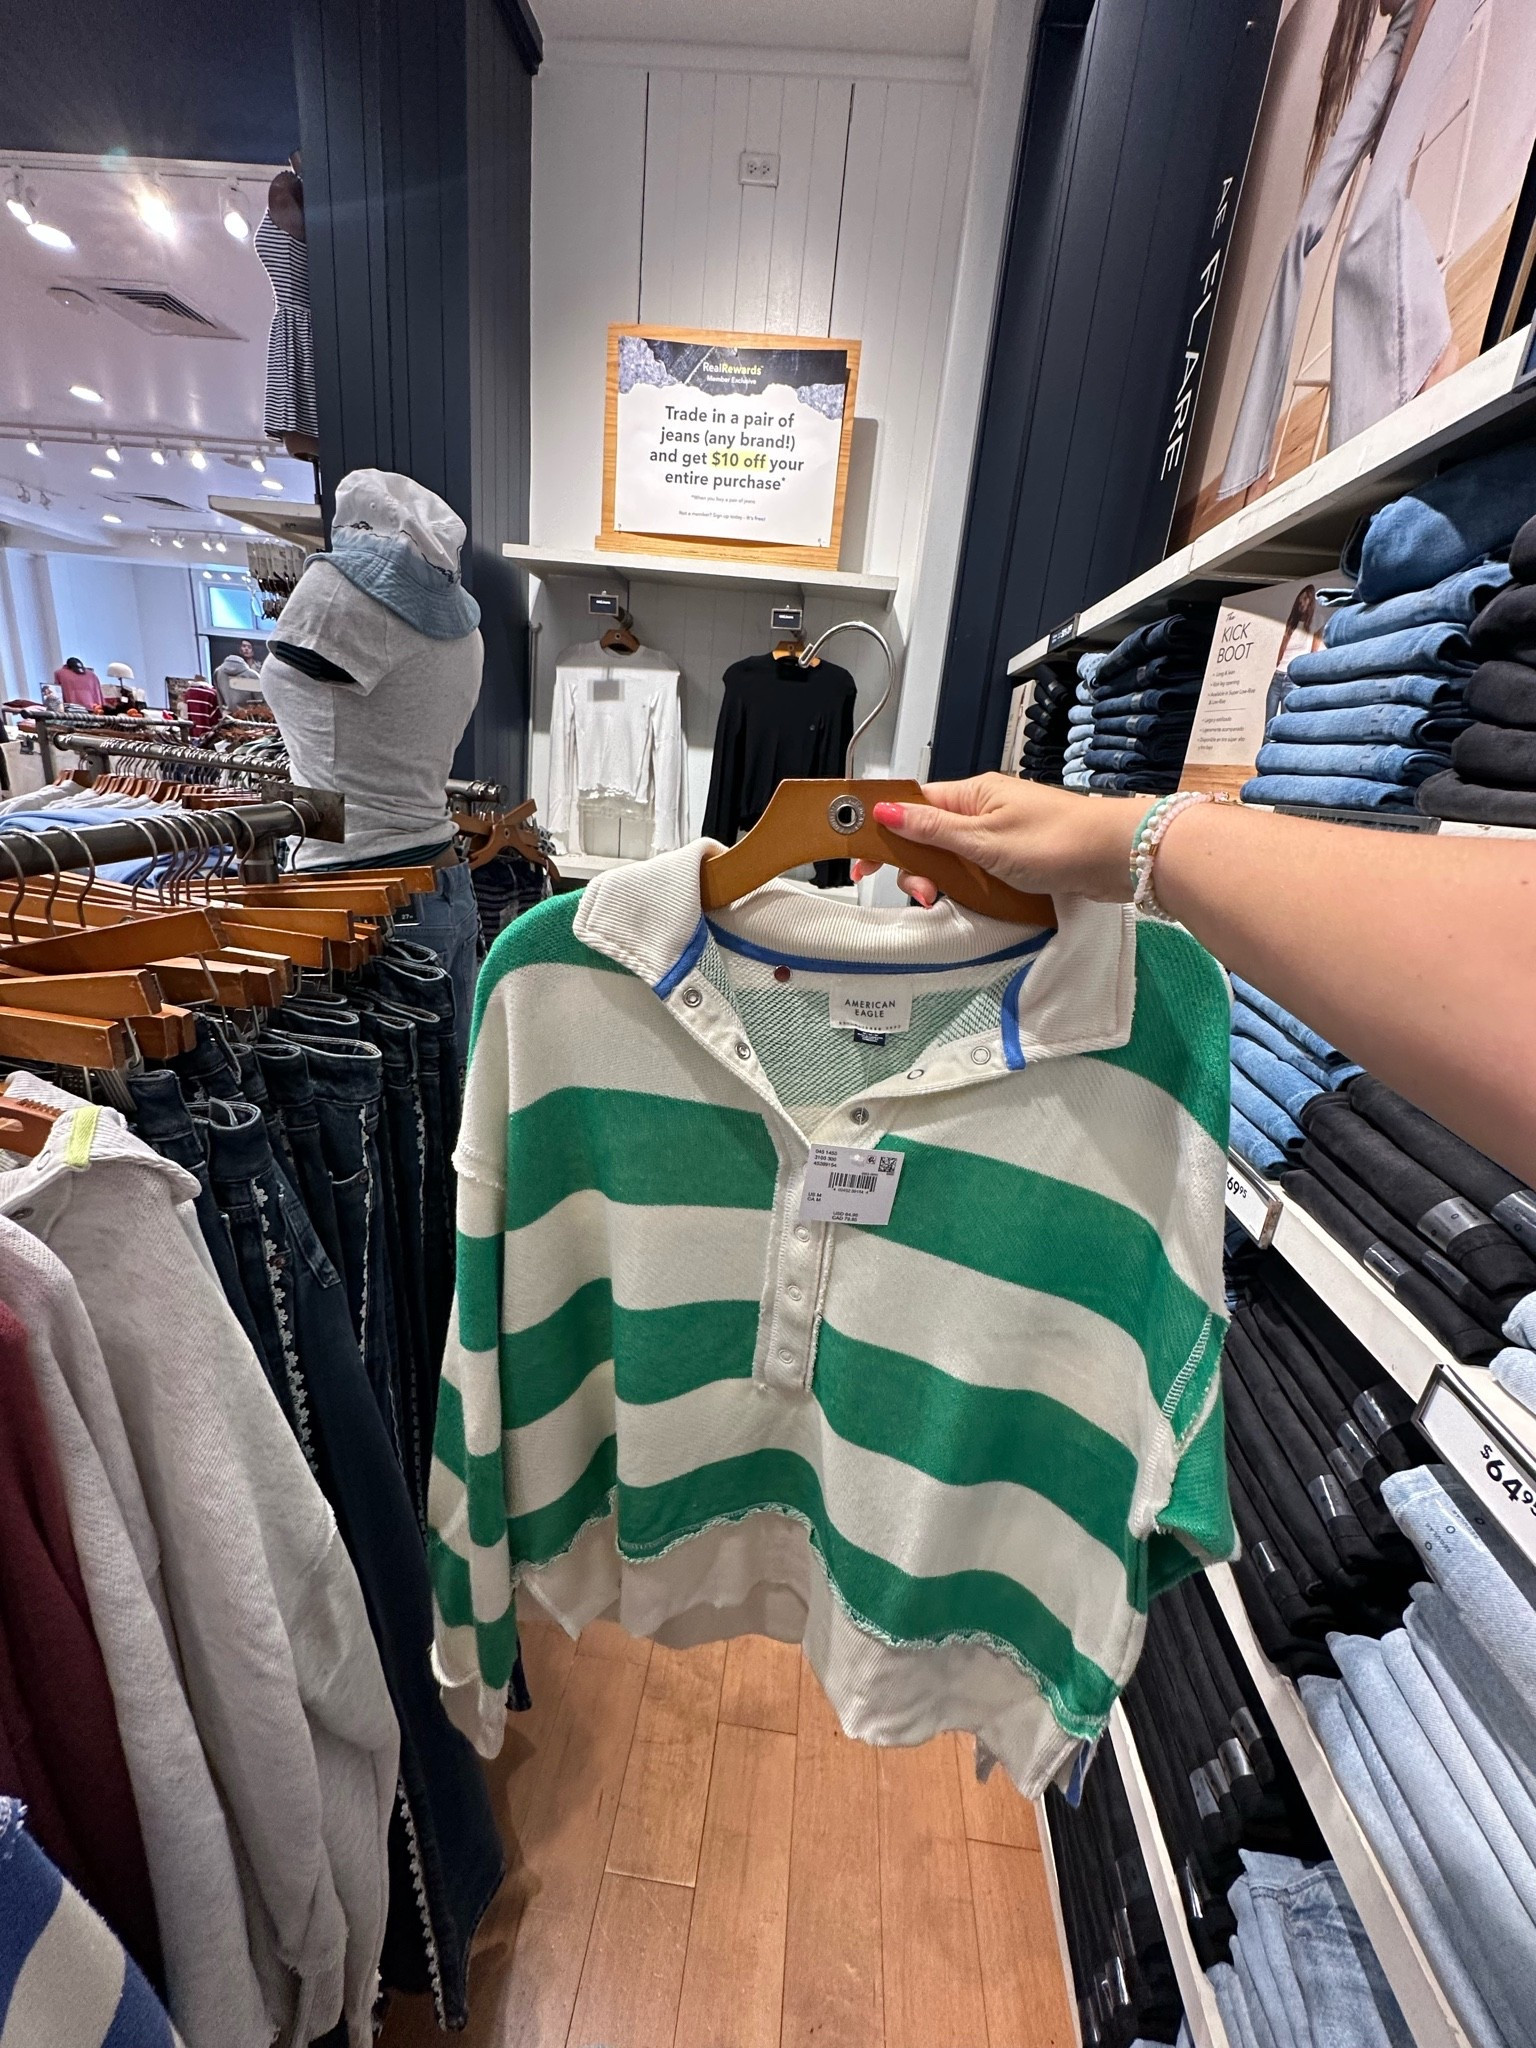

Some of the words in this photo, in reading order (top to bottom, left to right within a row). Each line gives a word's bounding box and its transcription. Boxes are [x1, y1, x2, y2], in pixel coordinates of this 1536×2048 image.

[1211, 176, 1234, 239] AE
[1160, 248, 1221, 481] FLARE
[665, 405, 707, 422] Trade
[712, 408, 726, 424] in
[730, 413, 739, 424] a
[743, 411, 774, 429] pair
[778, 412, 795, 428] of
[659, 426, 700, 445] jeans
[704, 430, 736, 449] (any
[740, 431, 795, 452] brand!)
[649, 448, 678, 463] and
[682, 451, 708, 467] get
[711, 451, 739, 467] $10
[743, 453, 766, 469] off
[769, 458, 804, 473] your
[665, 470, 709, 486] entire
[1221, 622, 1251, 644] KICK
[1216, 642, 1254, 664] BOOT
[844, 998, 896, 1009] AMERICAN
[854, 1008, 885, 1018] EAGLE
[1445, 1525, 1456, 1534] 0
[1424, 1541, 1433, 1551] 0
